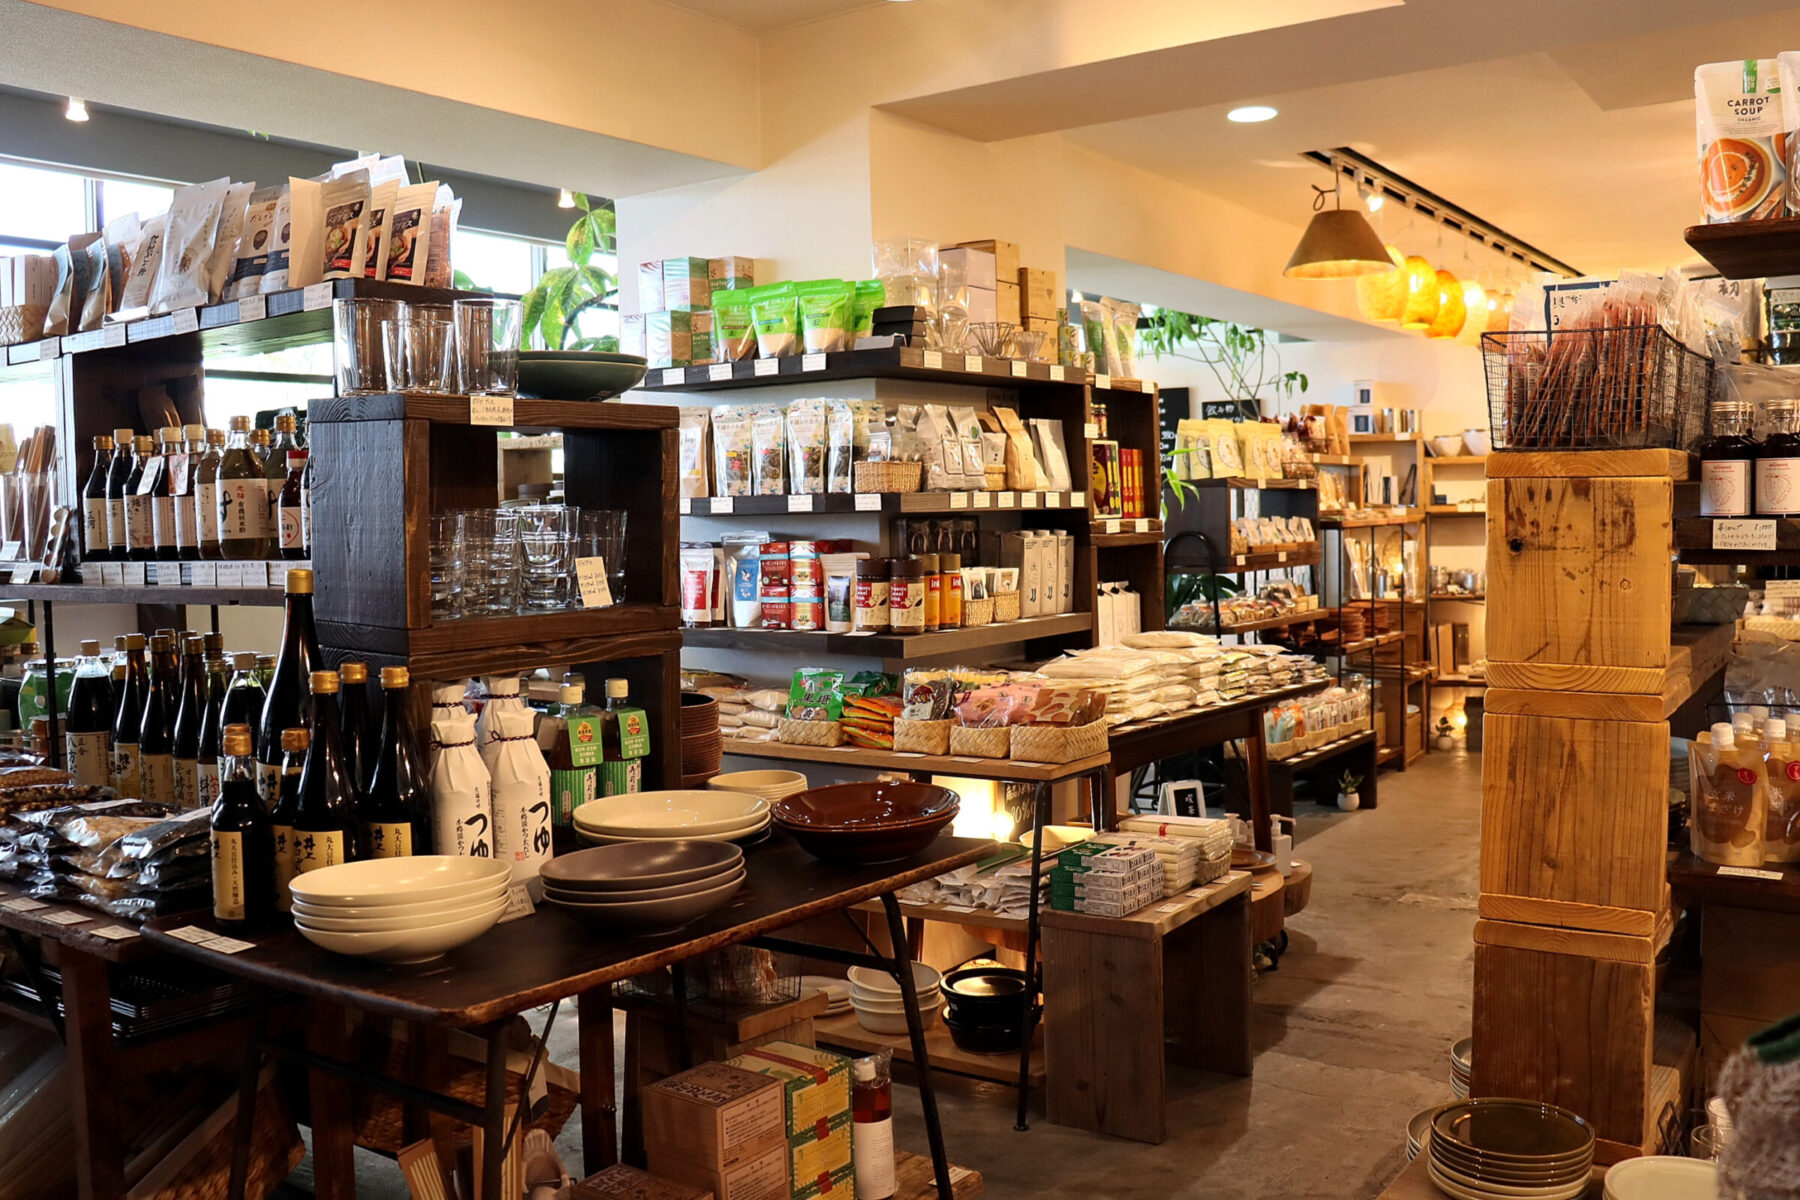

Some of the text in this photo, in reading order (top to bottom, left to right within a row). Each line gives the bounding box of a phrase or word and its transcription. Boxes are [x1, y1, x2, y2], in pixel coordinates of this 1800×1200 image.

[1727, 96, 1770, 107] CARROT
[1734, 106, 1763, 116] SOUP
[802, 693, 831, 705] 黒糖
[374, 825, 386, 851] 井上
[464, 813, 490, 857] つゆ
[528, 800, 551, 857] つゆ
[303, 833, 316, 860] 井上
